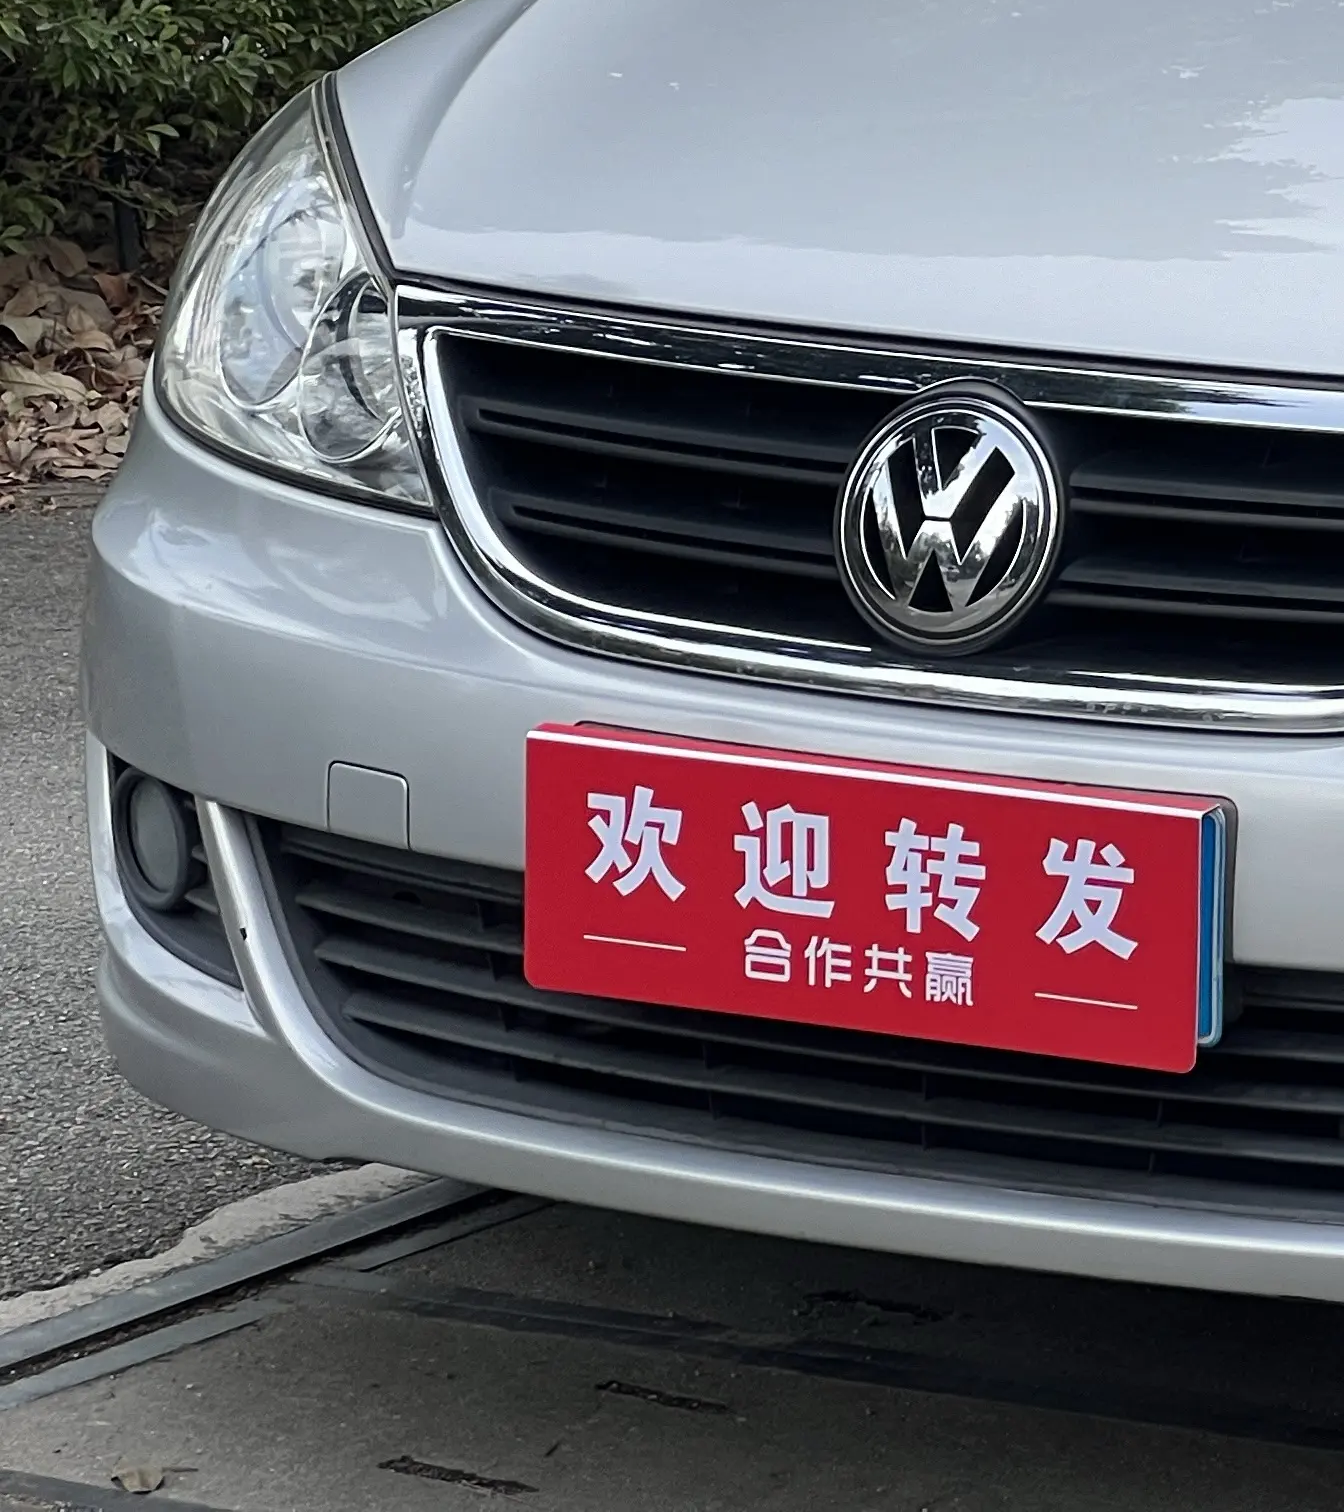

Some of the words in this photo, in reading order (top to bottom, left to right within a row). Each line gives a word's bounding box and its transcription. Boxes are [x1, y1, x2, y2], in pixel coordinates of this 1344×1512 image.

[585, 785, 1138, 960] 欢迎转发
[744, 928, 974, 1007] 合作共赢
